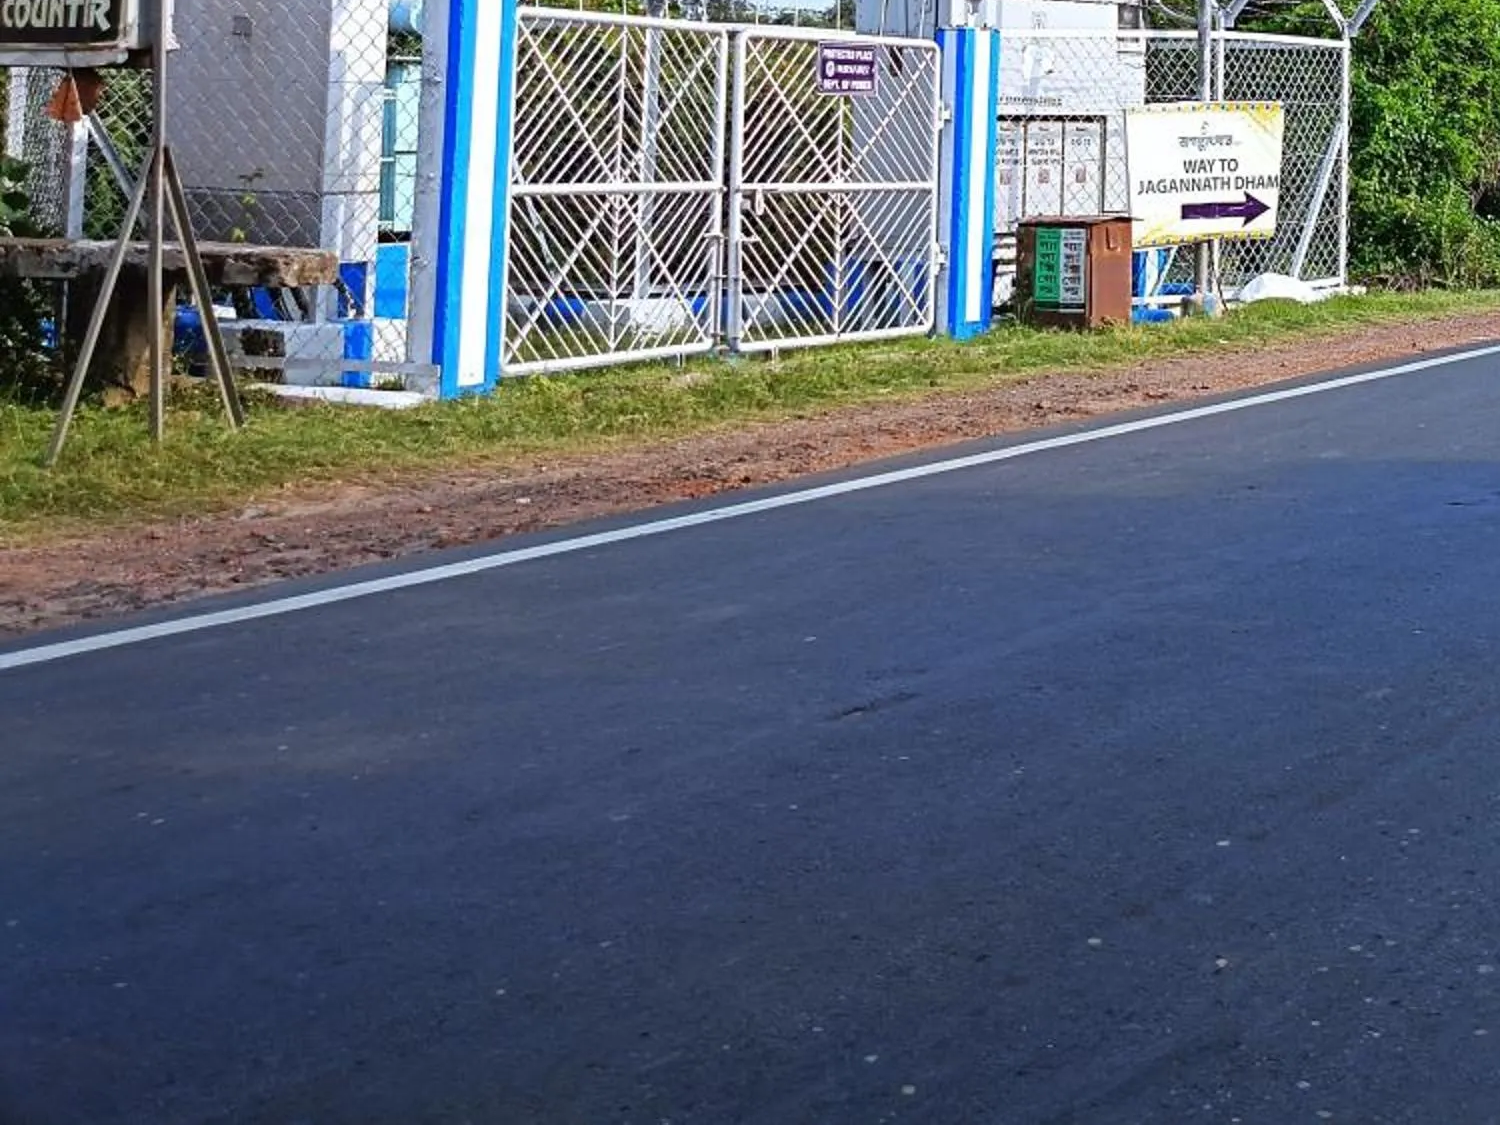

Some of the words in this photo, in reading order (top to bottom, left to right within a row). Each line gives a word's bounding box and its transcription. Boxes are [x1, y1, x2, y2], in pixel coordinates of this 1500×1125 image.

[1183, 159, 1218, 174] WAY
[1219, 158, 1239, 172] TO
[1138, 177, 1231, 195] JAGANNATH
[1234, 175, 1279, 190] DHAM
